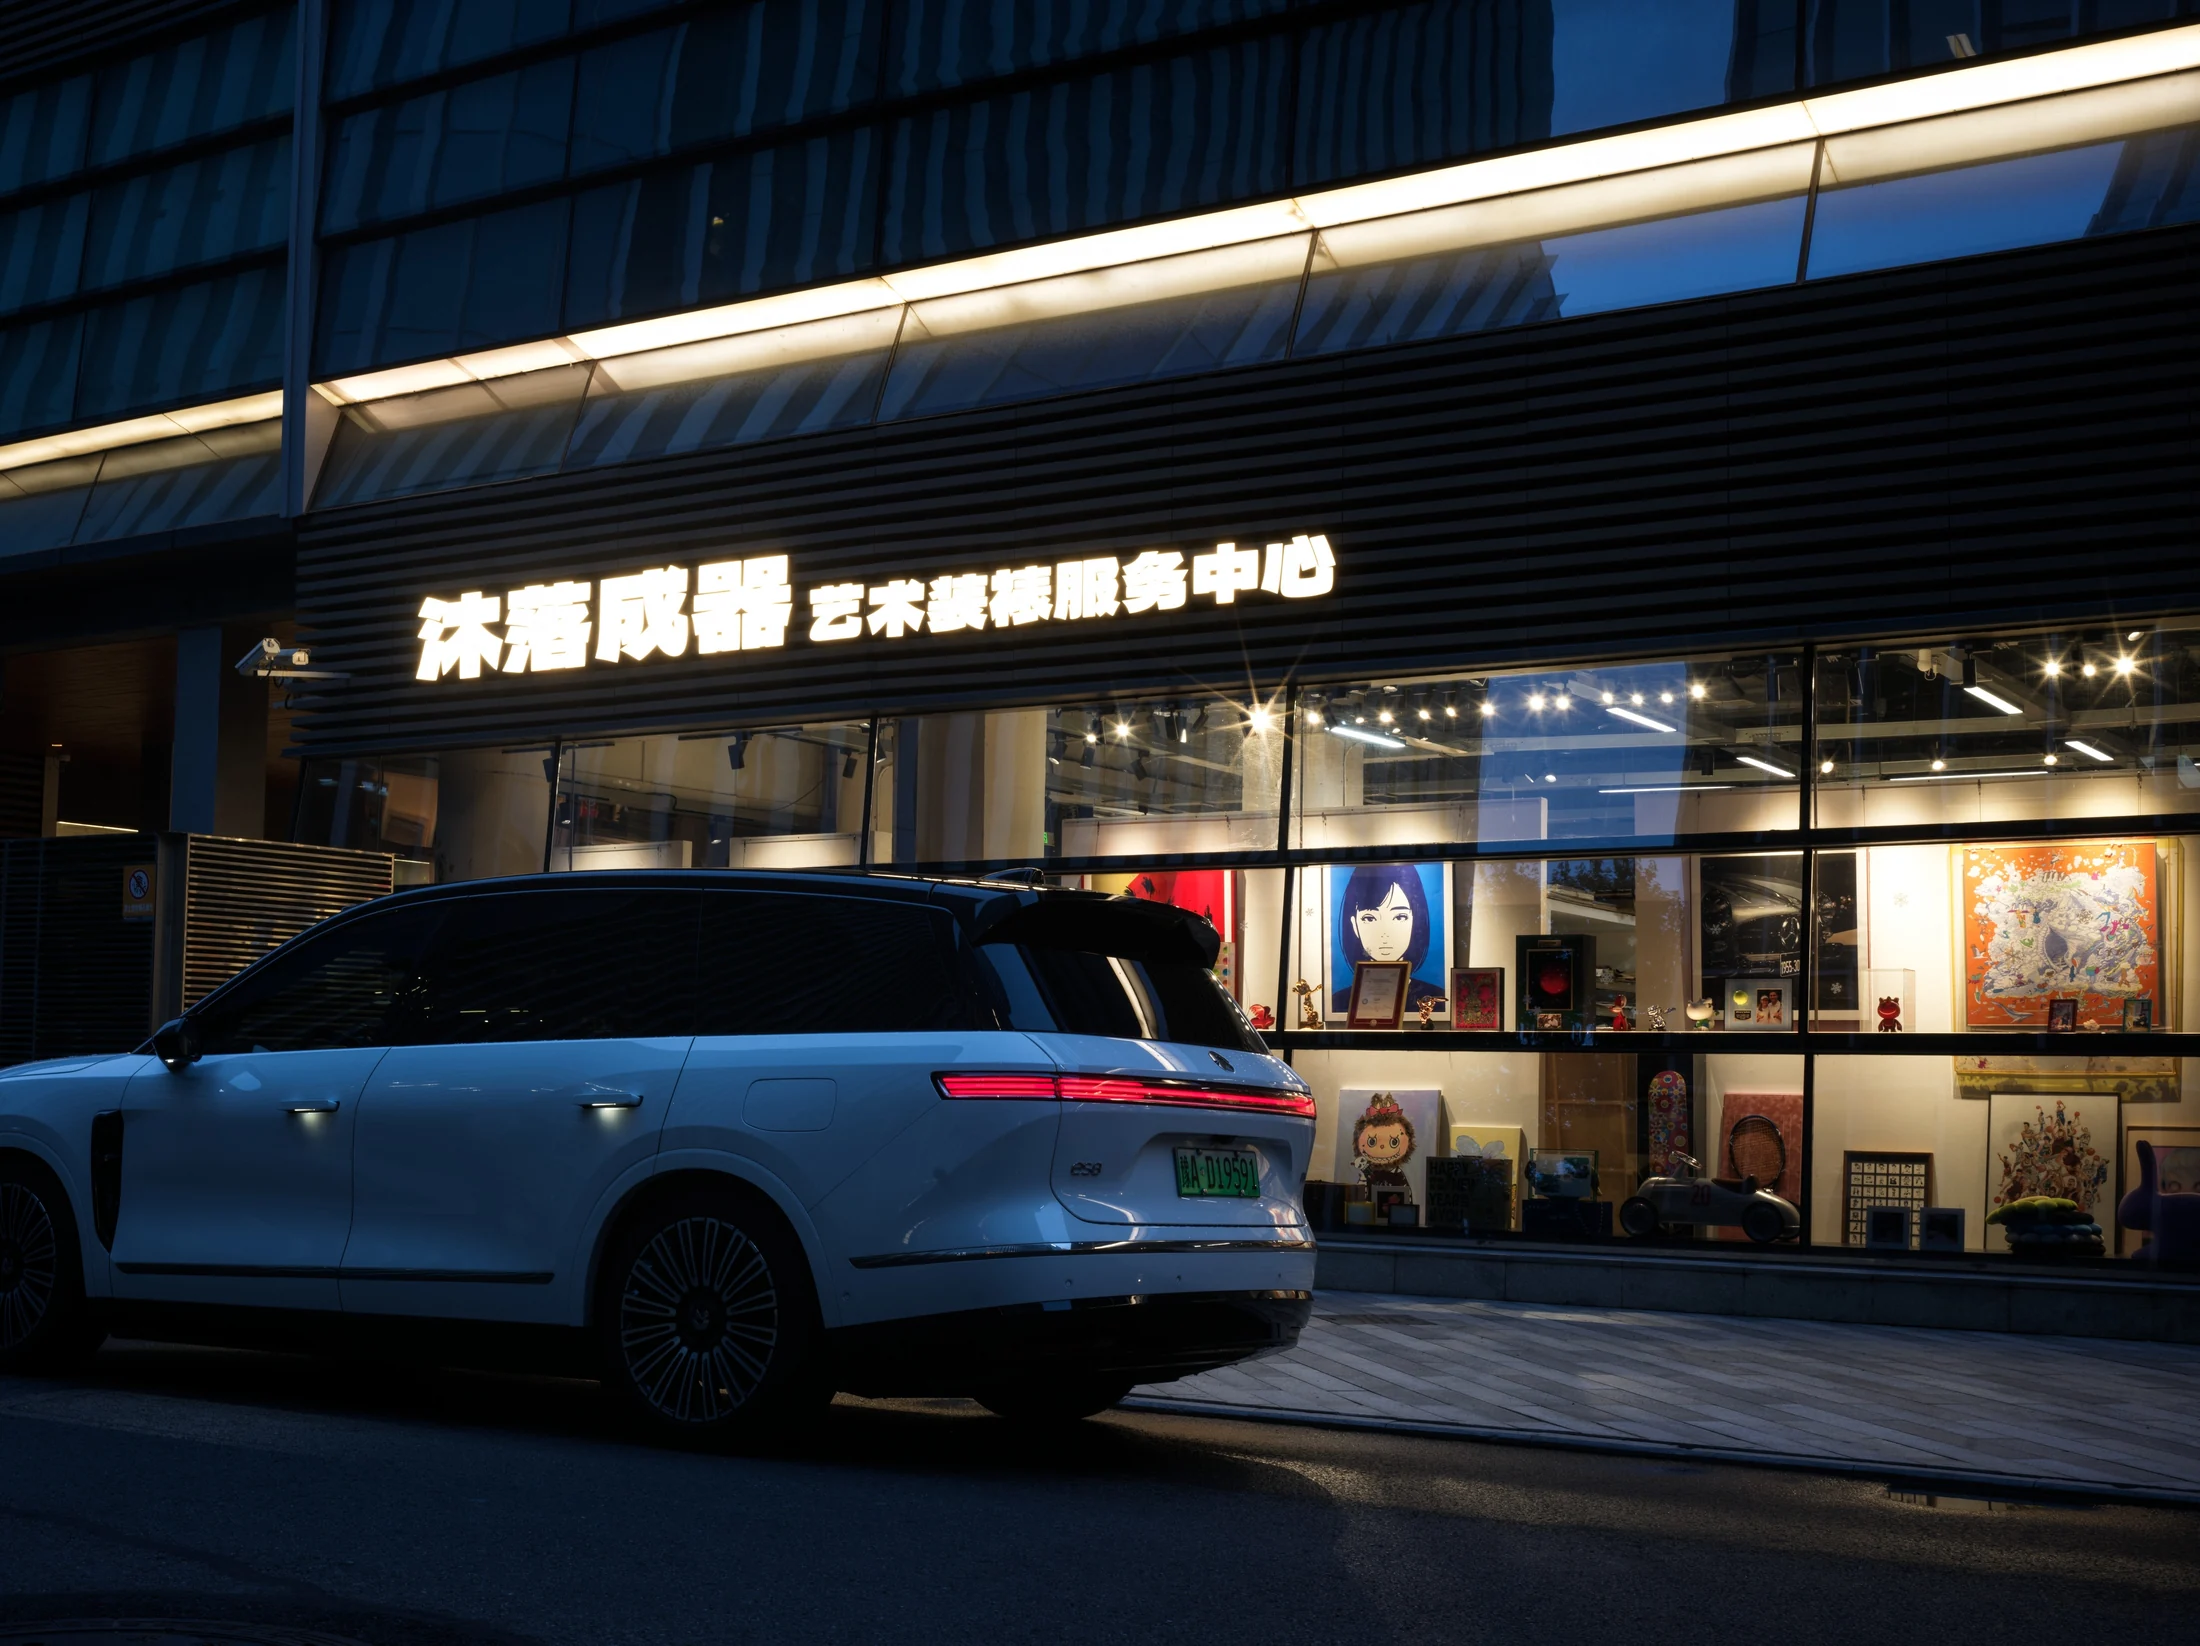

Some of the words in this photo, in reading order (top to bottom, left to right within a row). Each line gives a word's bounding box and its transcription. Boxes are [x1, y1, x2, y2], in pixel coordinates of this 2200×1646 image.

[415, 554, 793, 681] 沐落成器
[809, 534, 1336, 642] 艺术装裱服务中心
[1690, 1185, 1711, 1207] 20
